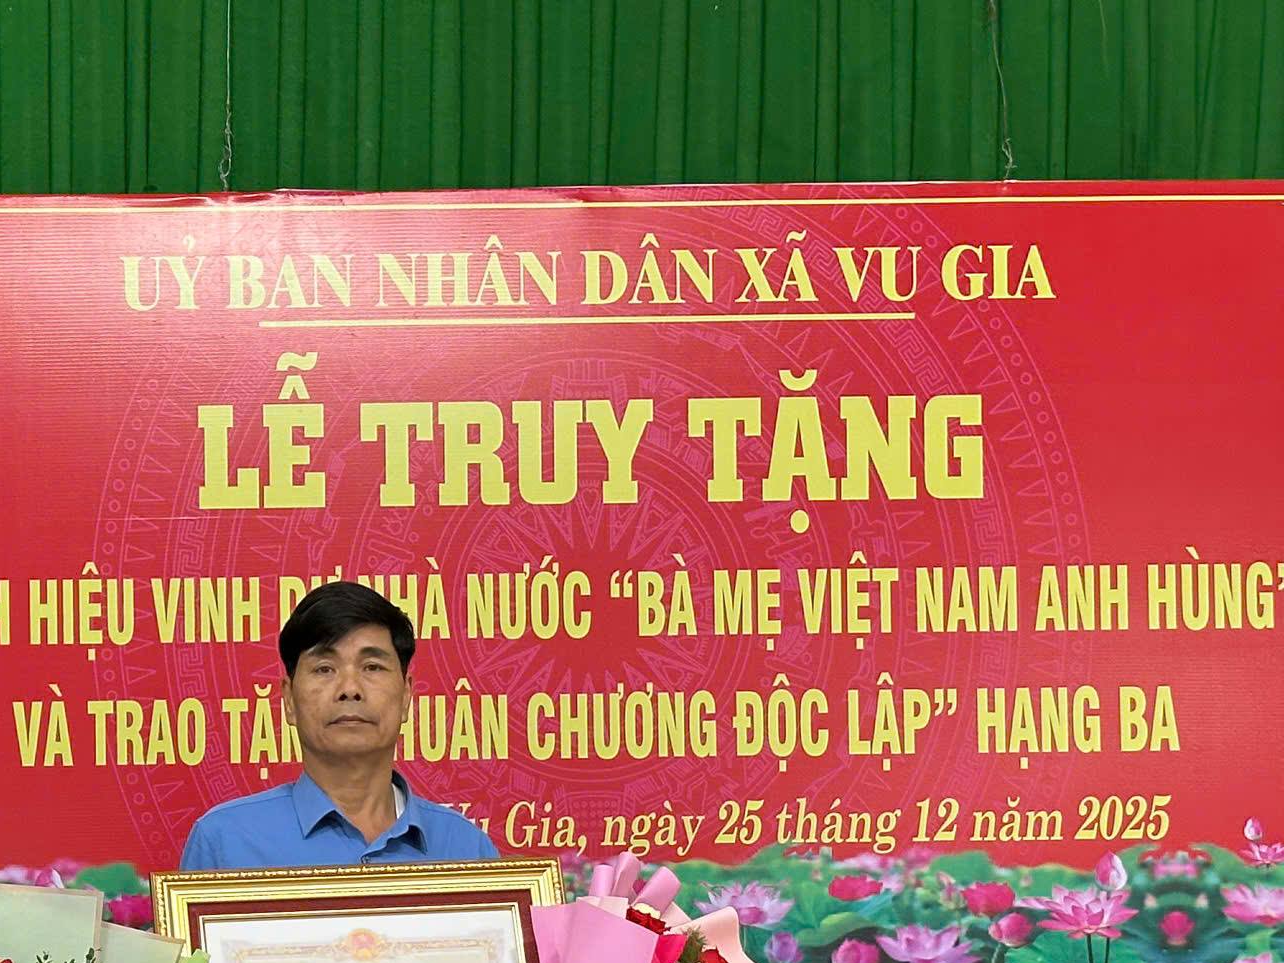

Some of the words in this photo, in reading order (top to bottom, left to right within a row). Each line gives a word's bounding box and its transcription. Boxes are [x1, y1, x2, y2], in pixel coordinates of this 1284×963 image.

[122, 235, 206, 312] UỶ
[225, 253, 354, 310] BAN
[375, 234, 562, 308] NHÂN
[580, 232, 718, 306] DÂN
[734, 229, 819, 303] XÃ
[832, 246, 920, 302] VU
[940, 244, 1057, 301] GIA
[197, 350, 326, 511] LỄ
[359, 398, 654, 508] TRUY
[687, 369, 985, 535] TẶNG
[29, 561, 135, 661] HIỆU
[150, 576, 261, 644] VINH
[466, 555, 592, 640] NƯỚC
[610, 553, 697, 638] “BÀ
[713, 569, 782, 651] MẸ
[797, 550, 900, 650] VIỆT
[915, 565, 1018, 633] NAM
[1034, 563, 1129, 632] ANH
[12, 683, 75, 767] VÀ
[87, 697, 206, 766] TRAO
[527, 682, 717, 761] CHƯƠNG
[732, 673, 829, 772] ĐỘC
[847, 671, 958, 771] LẬP”
[976, 685, 1102, 770] HẠNG
[1119, 685, 1181, 752] BA
[504, 801, 587, 858] Gia,
[600, 800, 707, 855] ngày
[714, 799, 765, 845] 25
[775, 798, 902, 854] tháng
[912, 797, 960, 842] 12
[969, 797, 1064, 842] năm
[1074, 794, 1172, 841] 2025
